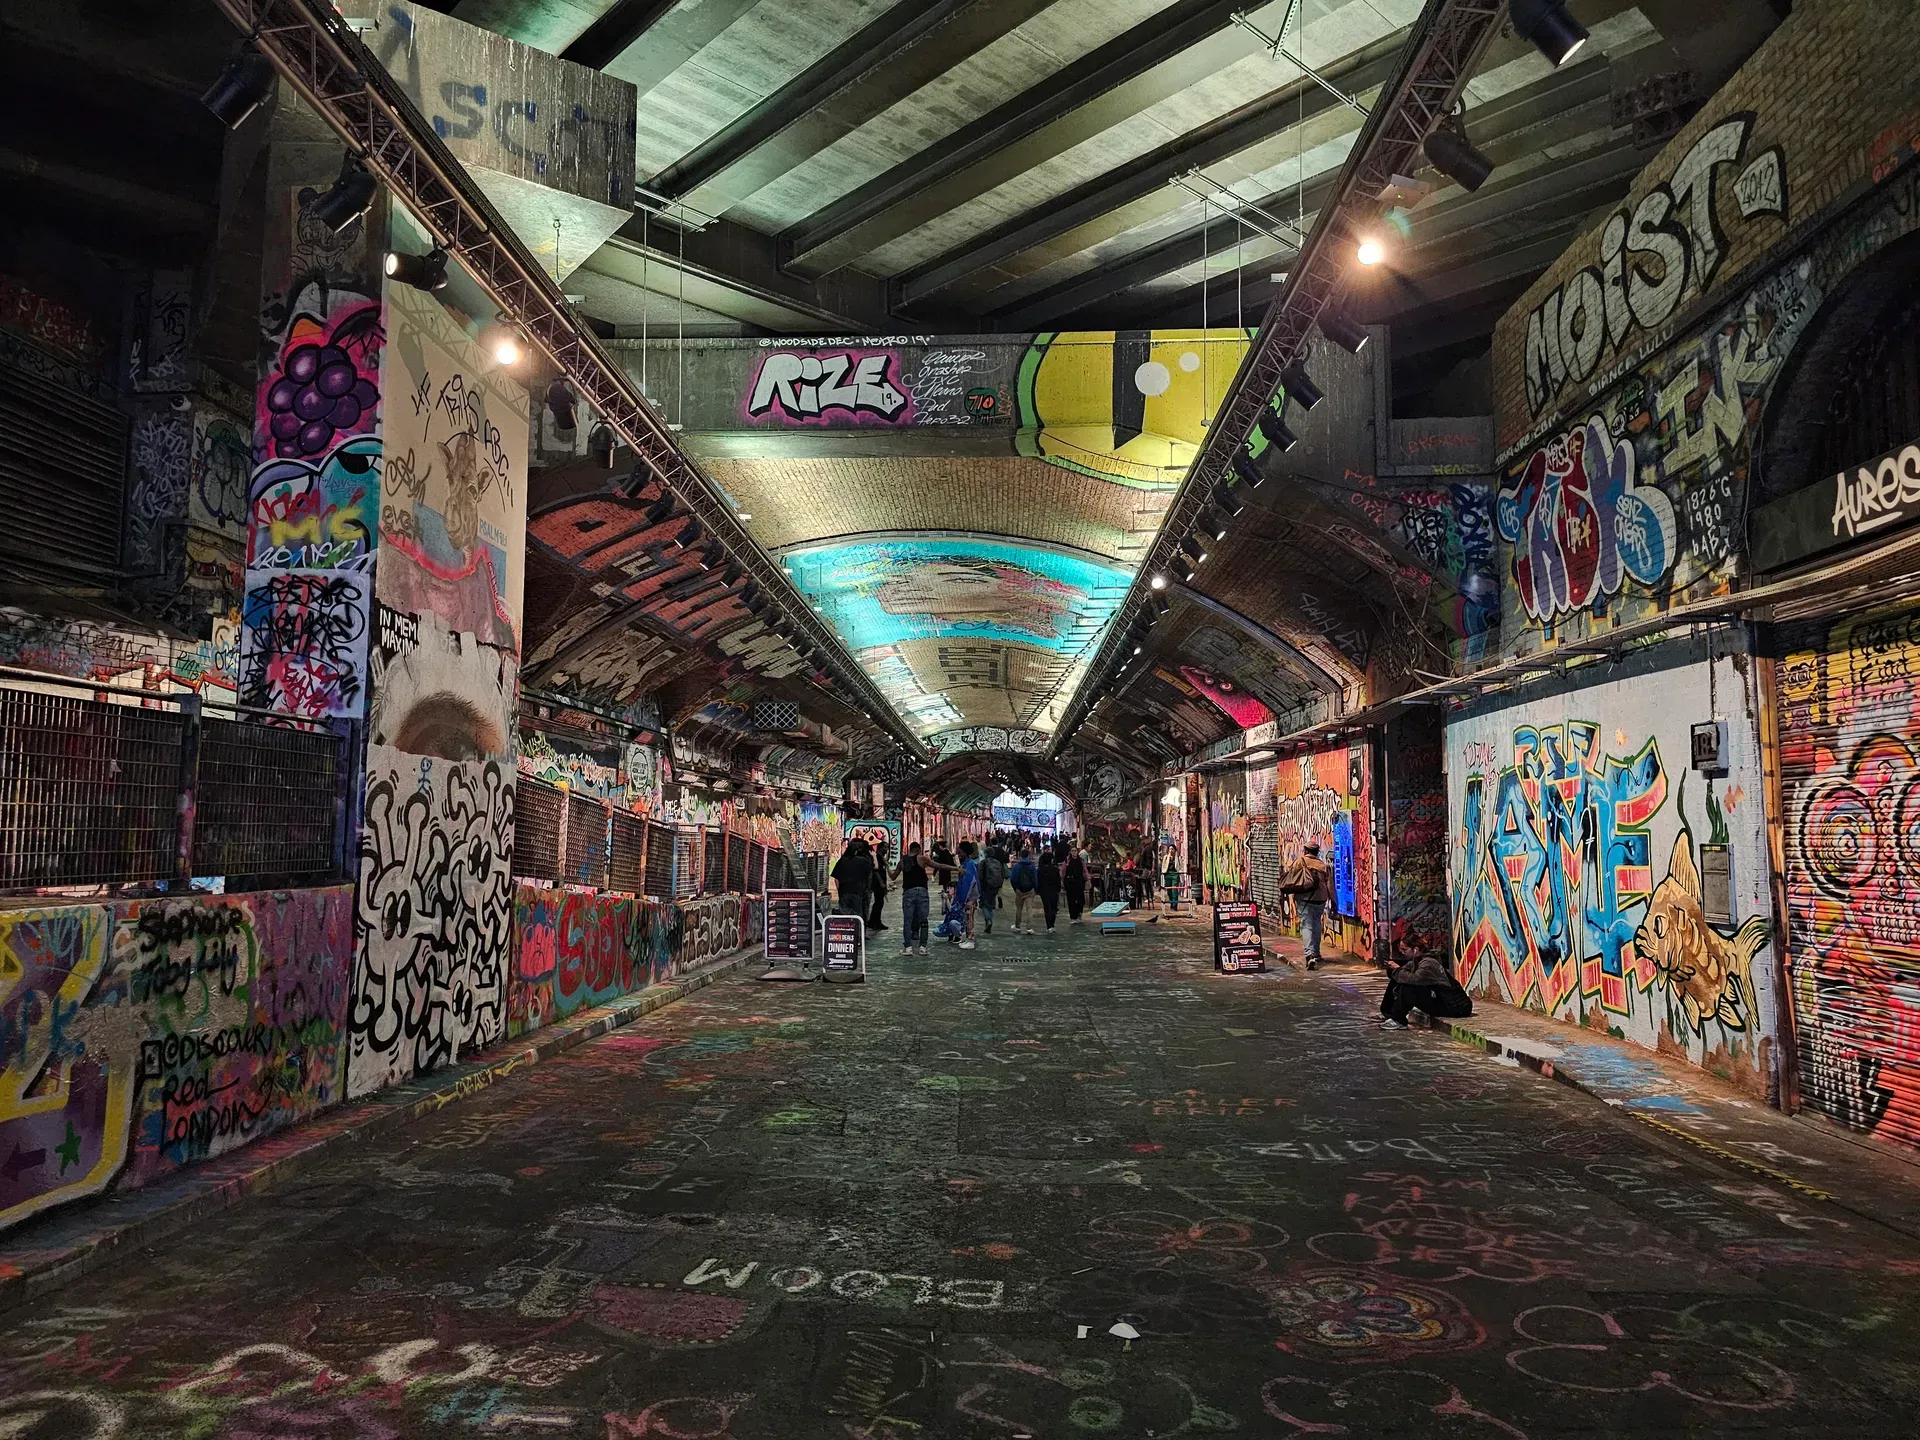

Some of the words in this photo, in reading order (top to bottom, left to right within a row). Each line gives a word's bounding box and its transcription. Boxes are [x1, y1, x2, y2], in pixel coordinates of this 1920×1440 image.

[1740, 162, 1778, 205] 2012
[1638, 324, 1675, 359] LULU
[1689, 505, 1723, 532] 1980
[379, 608, 391, 628] IN
[394, 613, 417, 638] MEM
[827, 942, 855, 954] DINNER
[682, 1257, 1005, 1310] BLOOM
